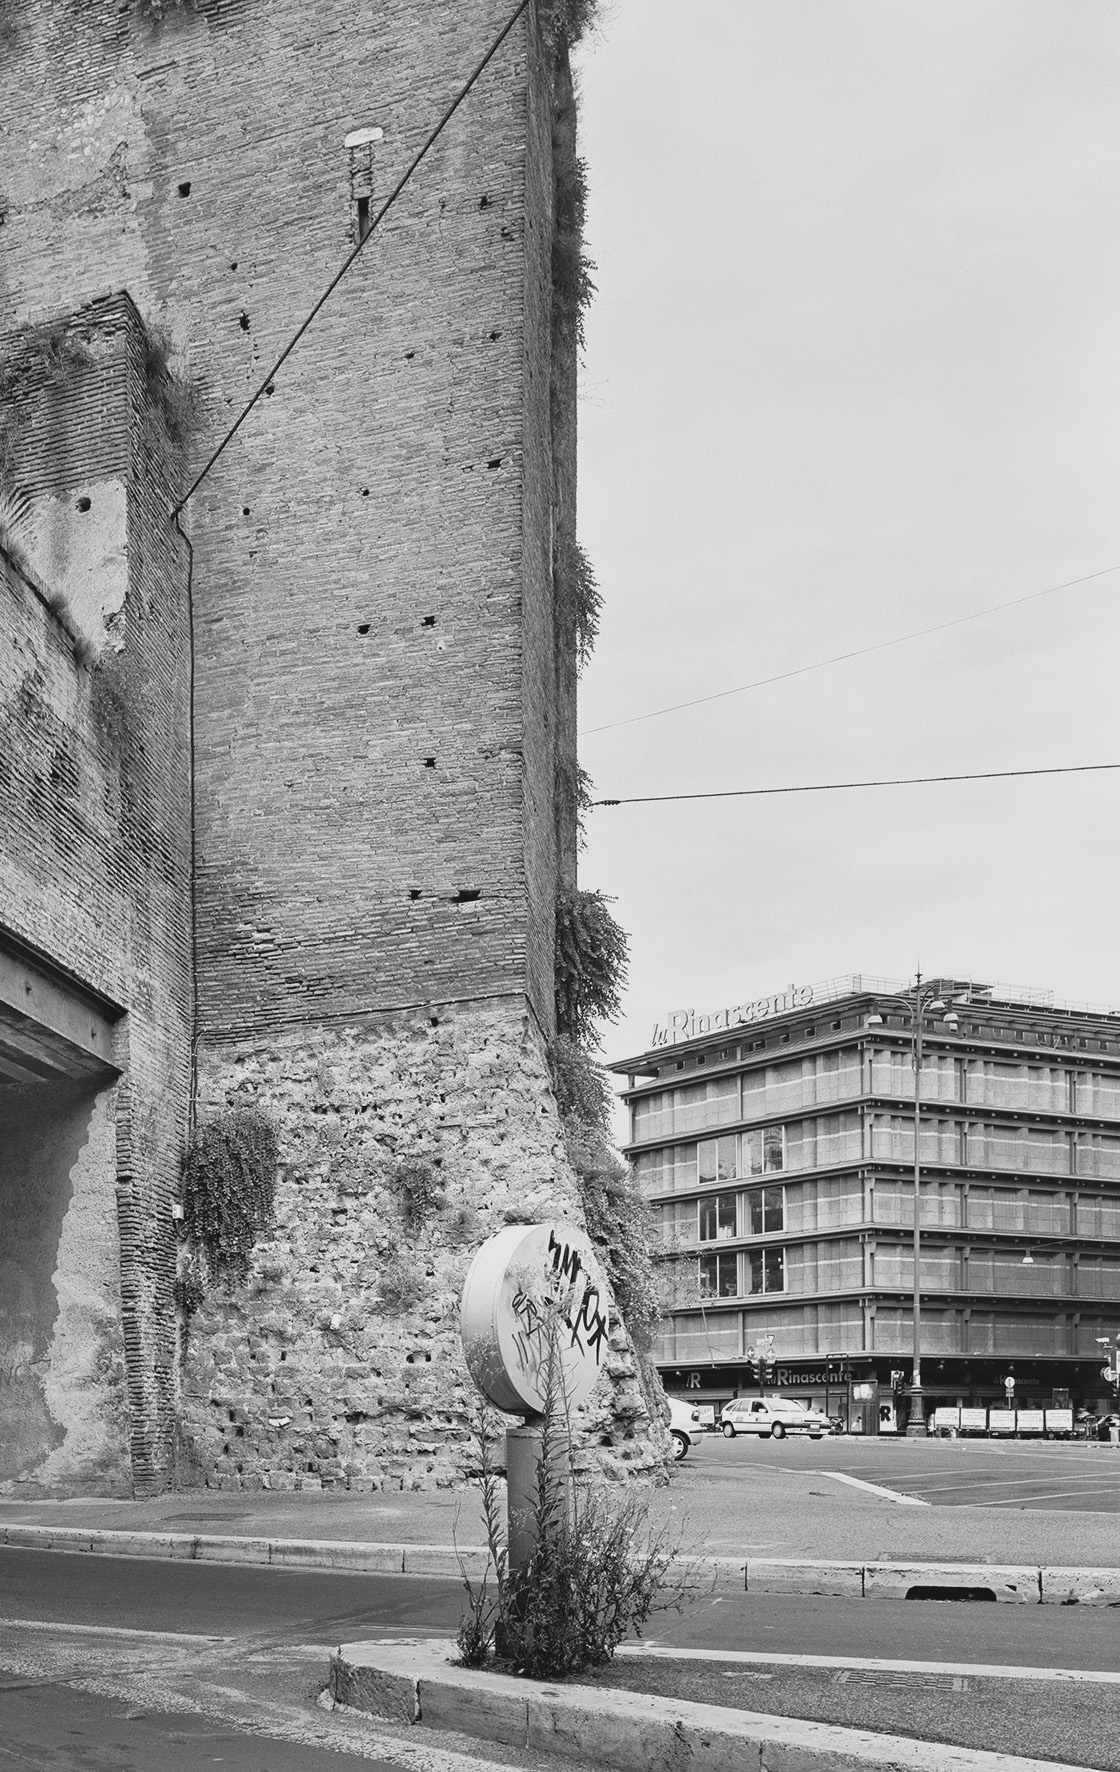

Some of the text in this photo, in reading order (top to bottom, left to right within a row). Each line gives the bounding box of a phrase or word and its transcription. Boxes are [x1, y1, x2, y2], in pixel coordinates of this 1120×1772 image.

[667, 983, 814, 1044] Rinascente
[777, 1368, 852, 1386] Rinascente
[880, 1405, 891, 1422] R
